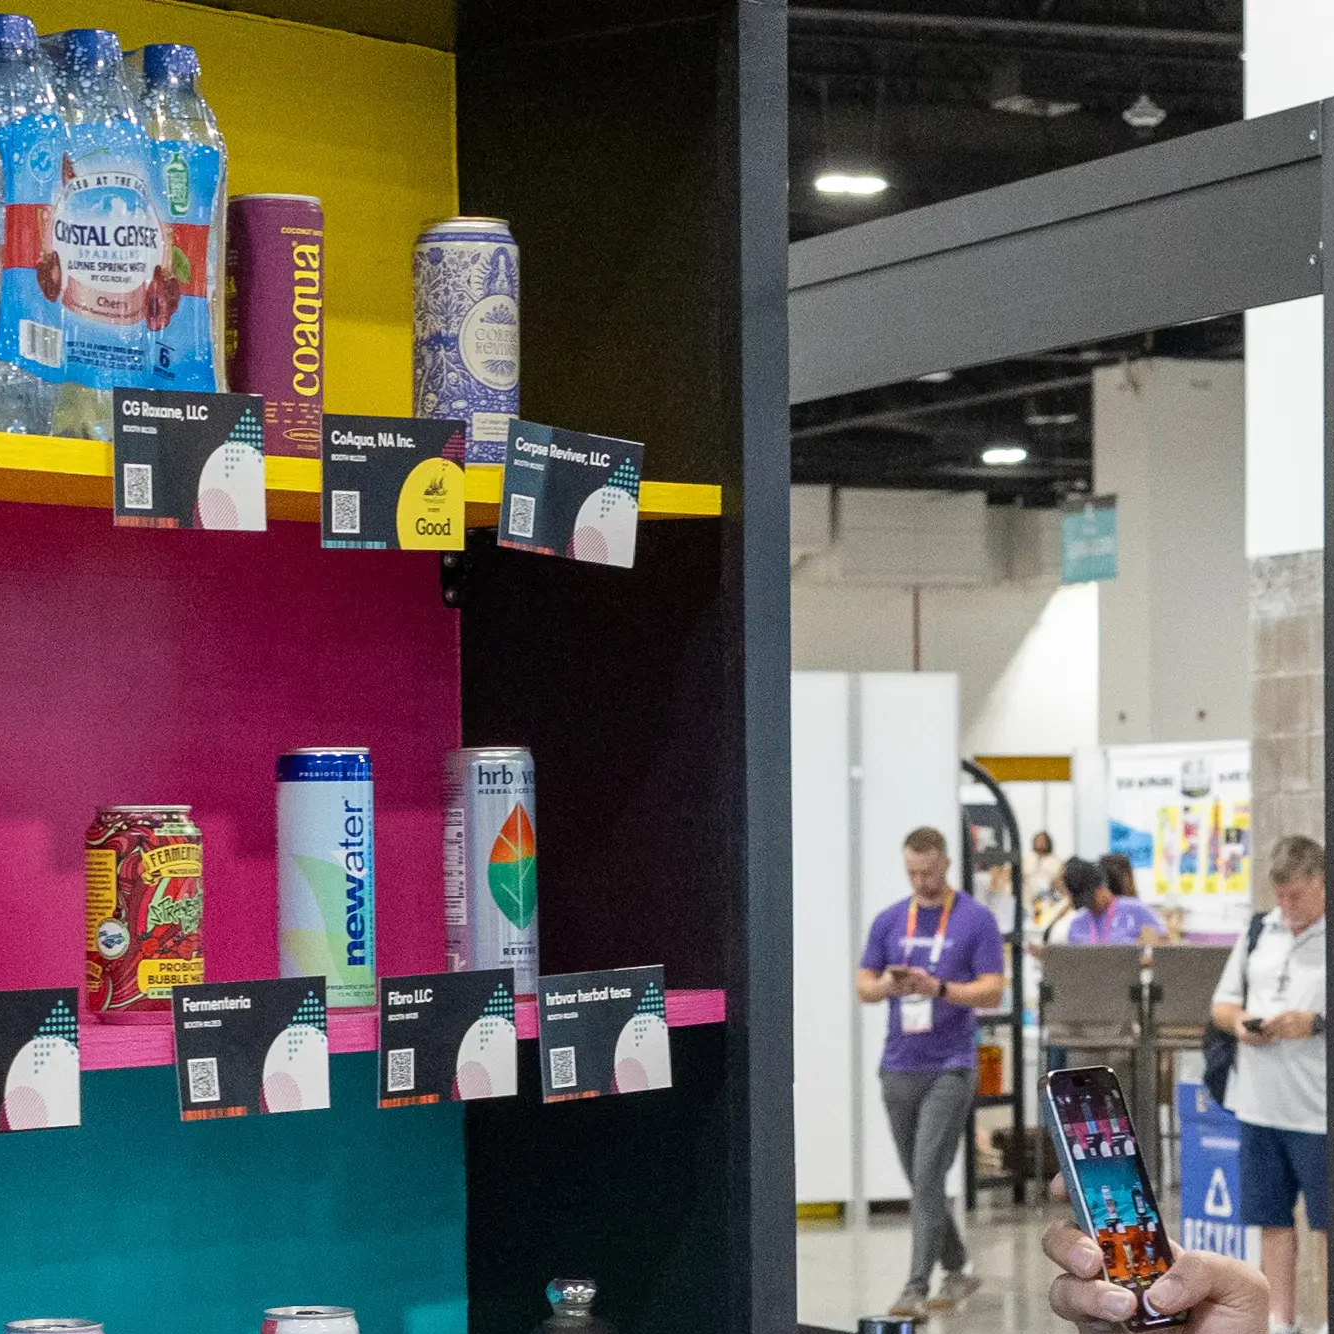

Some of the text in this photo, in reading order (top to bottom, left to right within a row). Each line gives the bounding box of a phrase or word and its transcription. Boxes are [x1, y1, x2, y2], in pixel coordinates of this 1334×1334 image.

[96, 176, 131, 186] AT THE
[55, 219, 158, 249] CRYSTAL GEYSER
[291, 243, 321, 397] coaqua
[122, 401, 208, 421] CG Roxane, LLC
[331, 430, 416, 449] CoAqua, NA Inc.
[515, 436, 550, 460] Corpse
[549, 444, 589, 466] Reviver,
[589, 451, 611, 467] LLC
[415, 517, 451, 537] Good
[339, 799, 366, 967] newater
[148, 974, 188, 985] BUBBLE
[182, 996, 251, 1013] Fermenteria
[388, 989, 434, 1005] Fibro LLC
[546, 987, 631, 1006] hrbvor herbal teas
